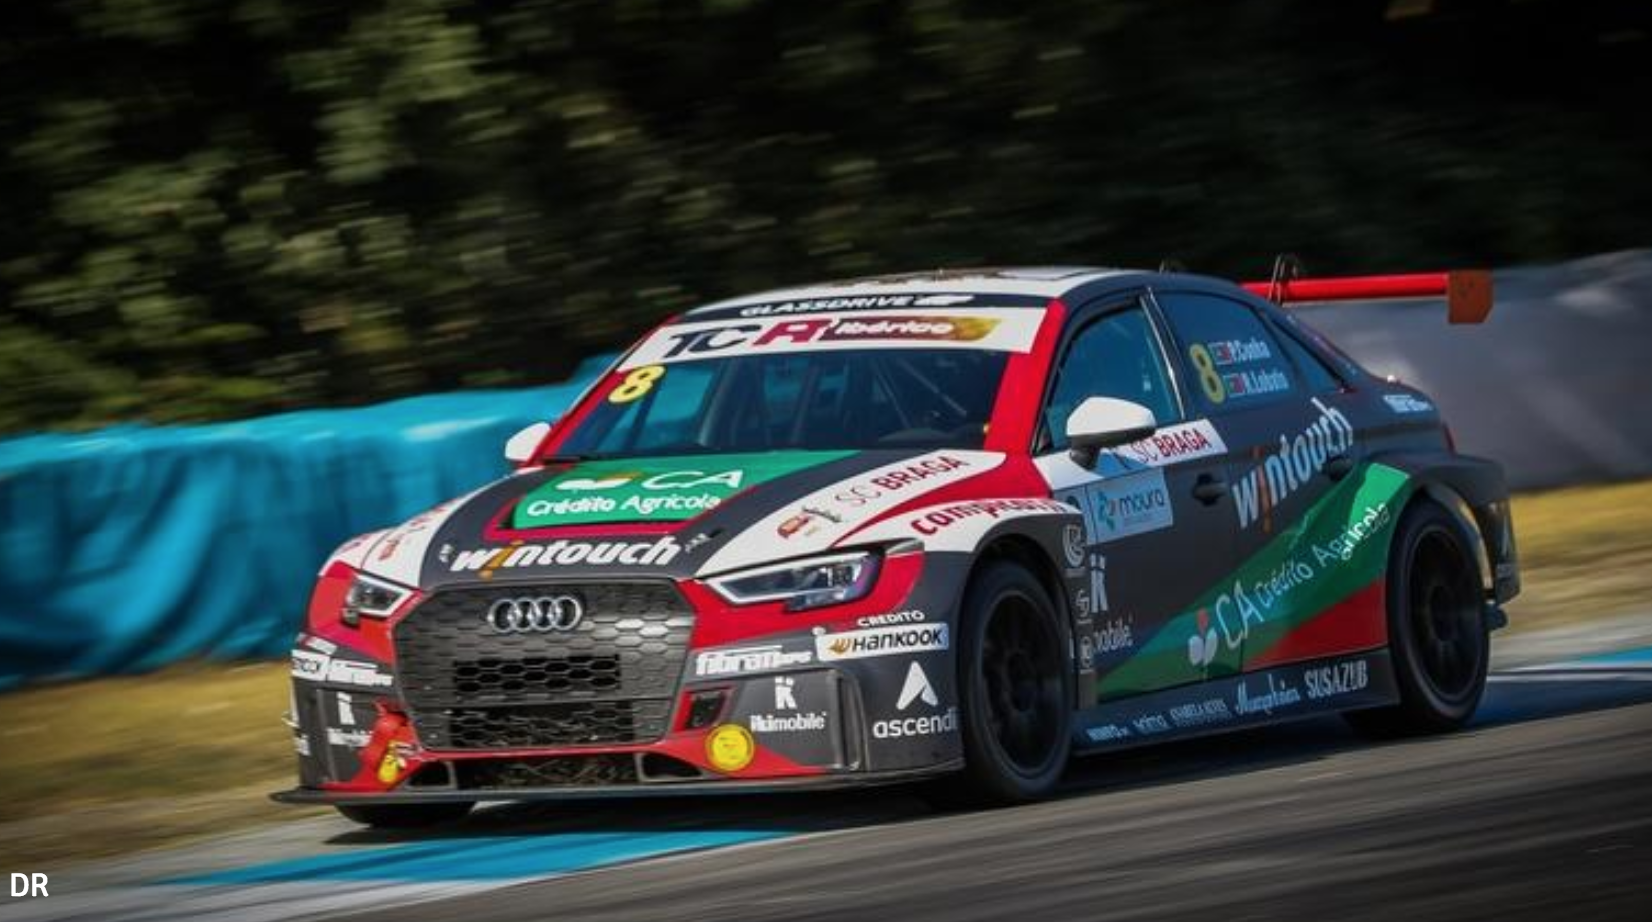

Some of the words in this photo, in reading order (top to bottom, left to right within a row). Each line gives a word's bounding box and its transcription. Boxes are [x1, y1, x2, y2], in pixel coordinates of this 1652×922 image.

[741, 296, 913, 317] GLASSDRIVE
[663, 317, 834, 359] TCR
[607, 364, 666, 404] 8
[1189, 343, 1224, 403] 8
[1152, 427, 1213, 458] BRAGA
[641, 469, 744, 490] CA
[834, 484, 882, 506] SC
[869, 455, 970, 491] BRAGA
[1231, 396, 1354, 534] wintouch
[1119, 488, 1165, 515] moura
[450, 536, 683, 582] wintouch
[1215, 580, 1265, 650] CA
